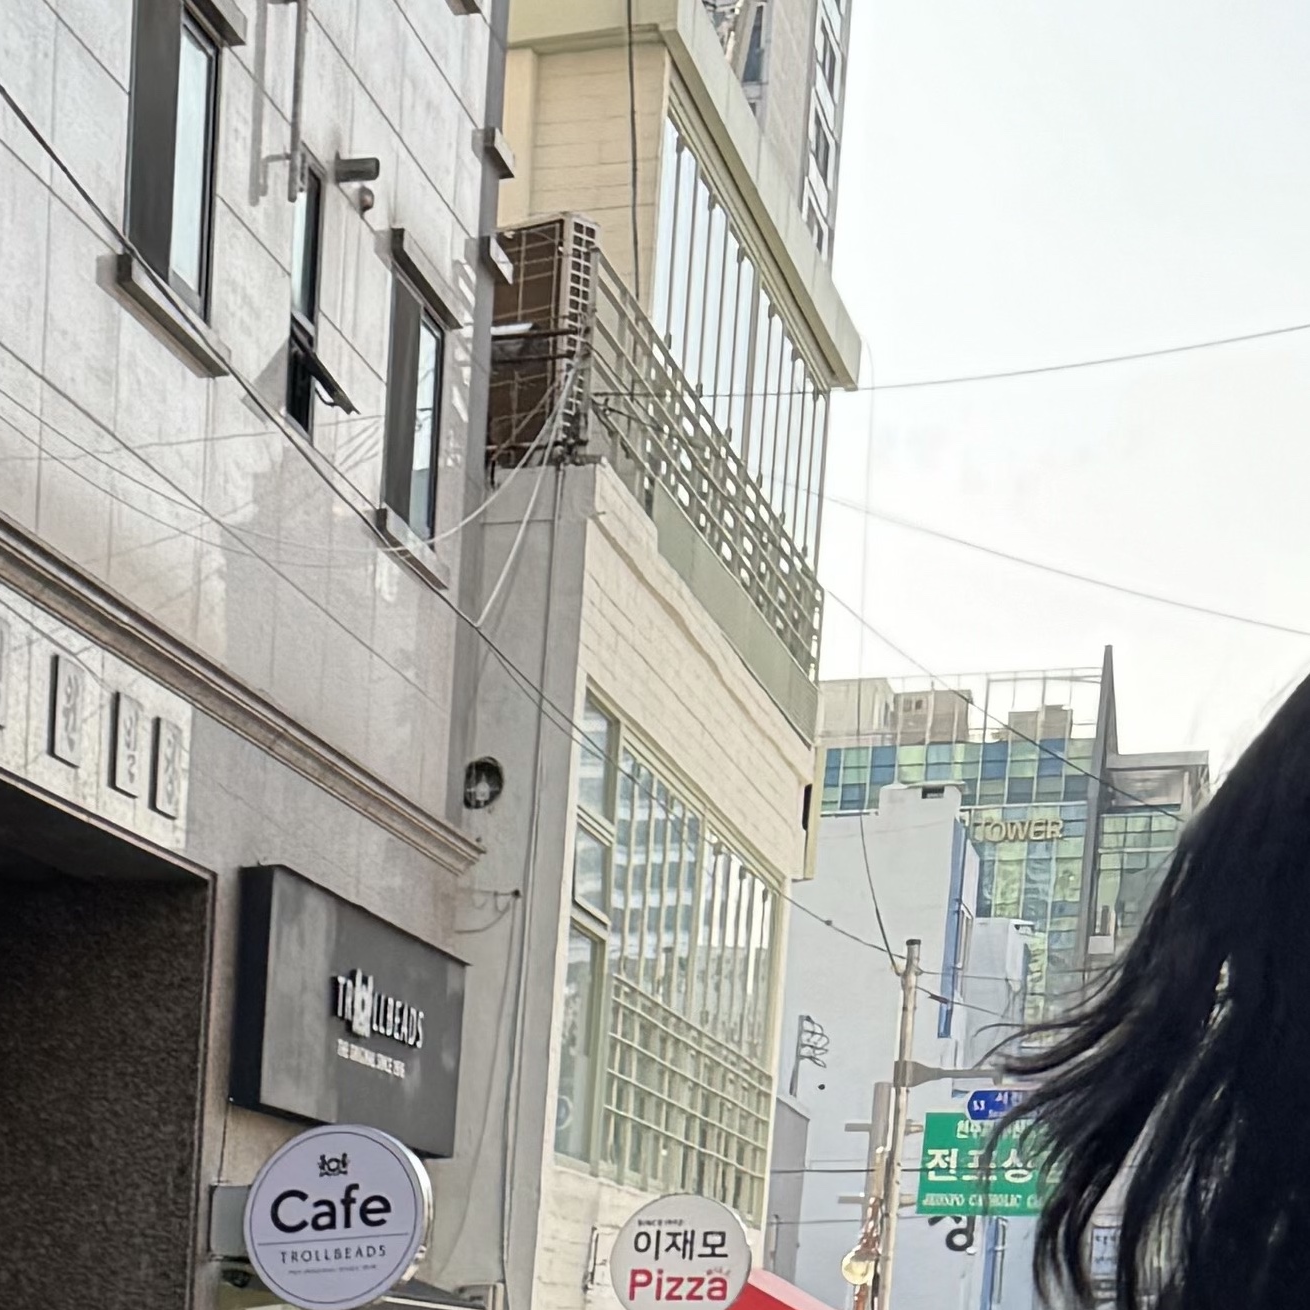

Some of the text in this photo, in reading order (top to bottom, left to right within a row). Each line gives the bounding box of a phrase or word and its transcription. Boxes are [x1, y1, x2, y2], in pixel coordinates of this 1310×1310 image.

[973, 818, 1064, 843] TOWER
[925, 1146, 1061, 1183] 전포성
[270, 1183, 392, 1234] Cafe
[968, 1192, 1022, 1208] CAHOLIC
[281, 1245, 387, 1264] TROLLBEADS
[633, 1229, 729, 1261] 이재모
[628, 1268, 728, 1302] Pizza
